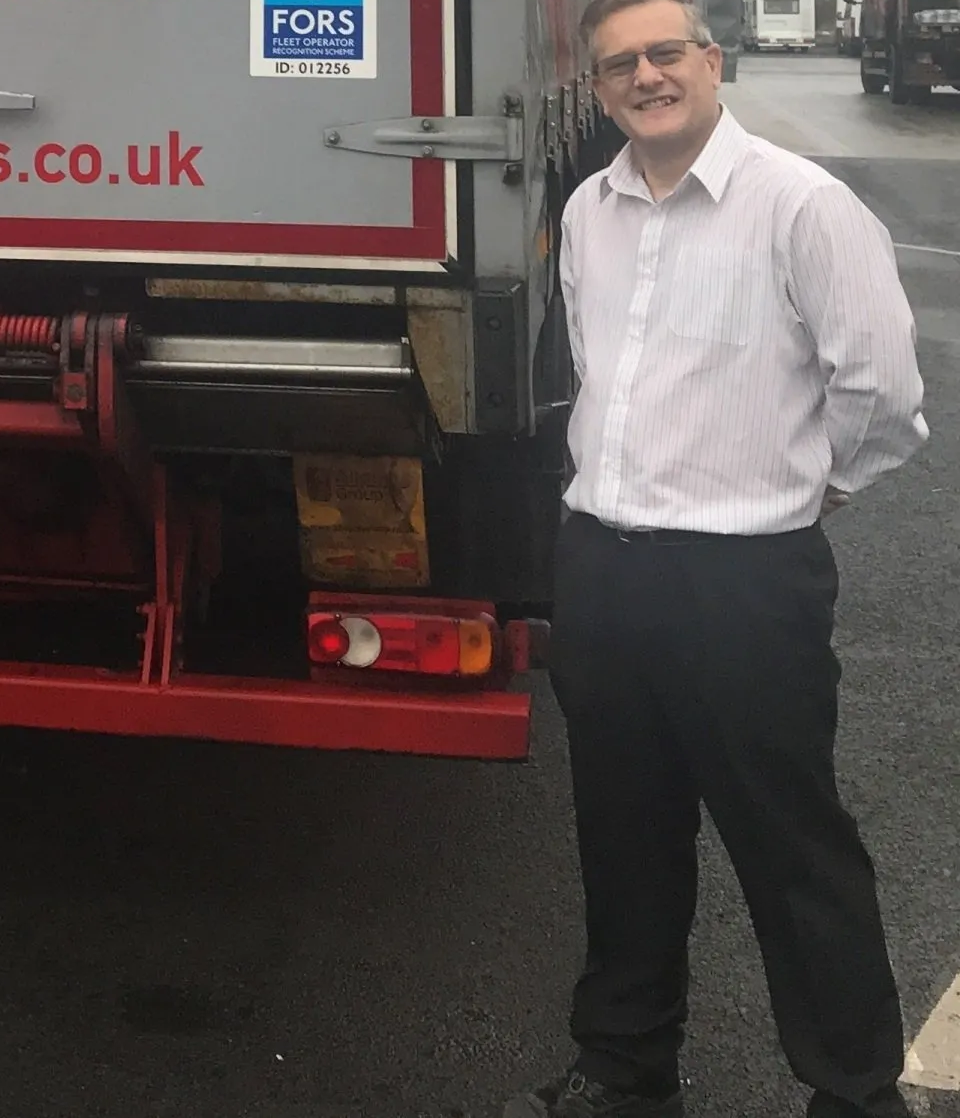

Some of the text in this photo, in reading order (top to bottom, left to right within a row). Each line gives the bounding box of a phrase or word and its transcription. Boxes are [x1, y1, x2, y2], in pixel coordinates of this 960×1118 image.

[272, 9, 355, 35] FORS
[272, 37, 355, 47] FLEET OPERATOR
[272, 47, 355, 56] RECOGNITION SCHEME
[275, 61, 351, 75] ID: 012256
